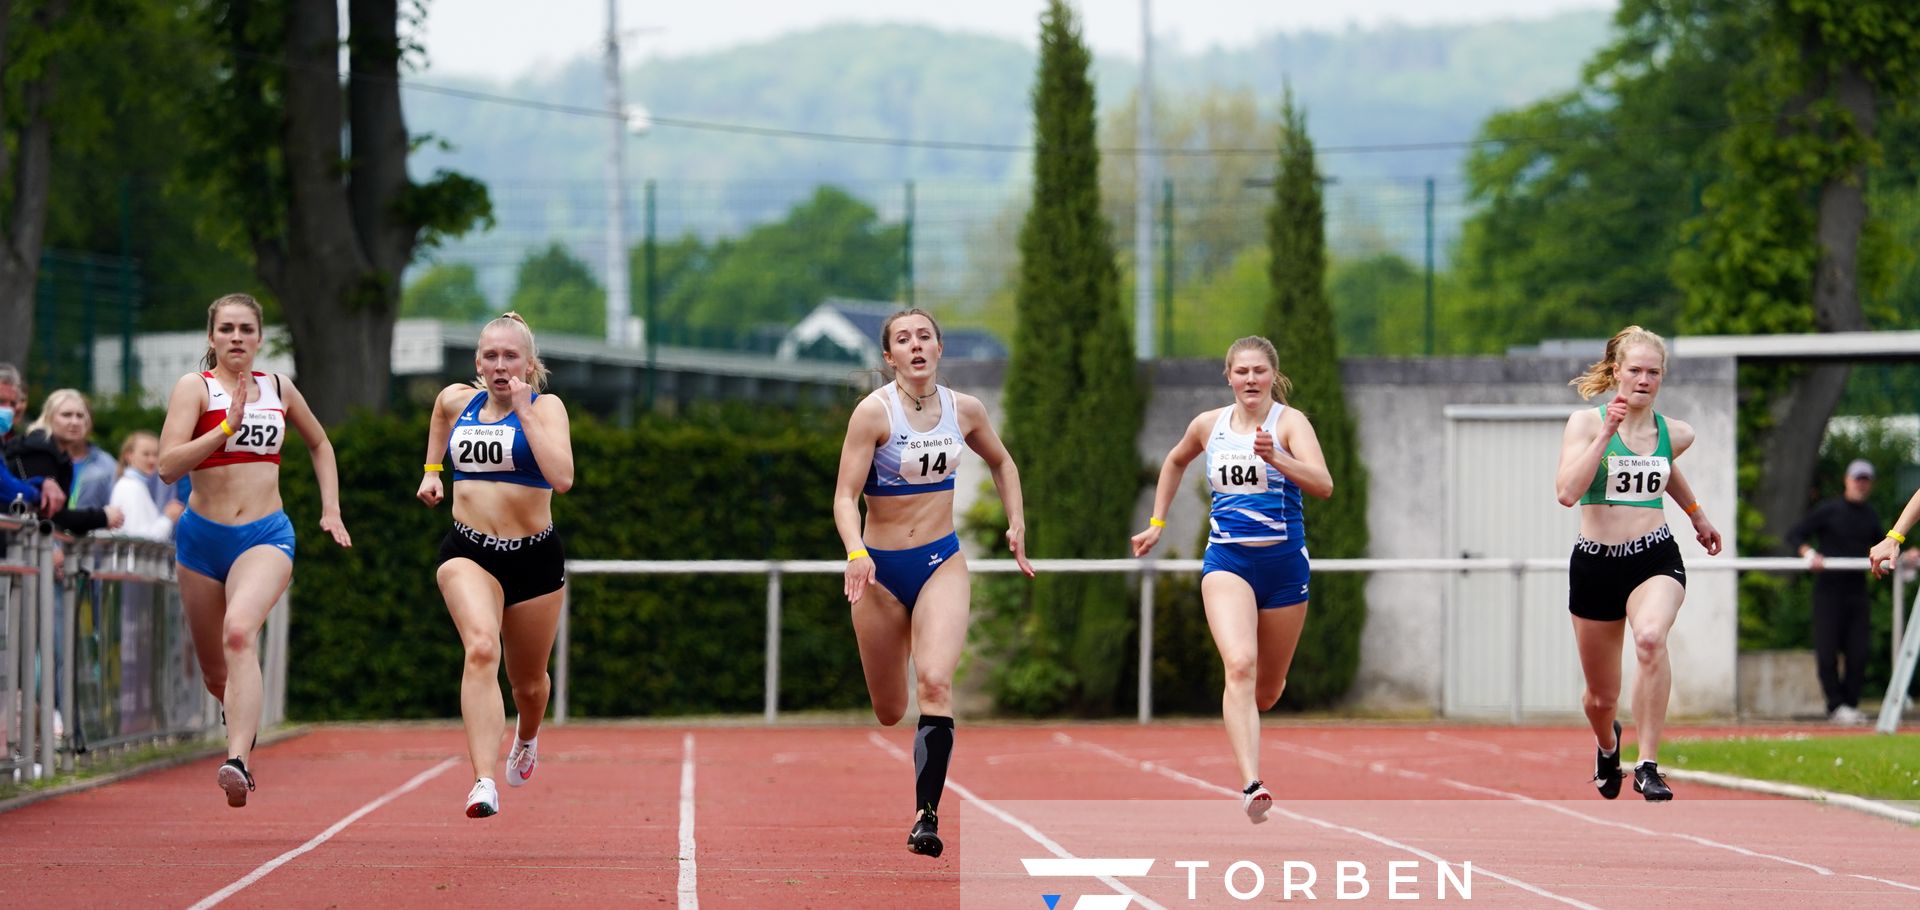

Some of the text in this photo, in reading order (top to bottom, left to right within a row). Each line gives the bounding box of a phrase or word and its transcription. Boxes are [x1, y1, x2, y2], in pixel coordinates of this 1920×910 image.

[235, 423, 278, 447] 252
[462, 428, 504, 437] SC Melle 03
[910, 440, 921, 449] SC
[923, 439, 943, 448] Melle
[944, 437, 953, 446] 03
[458, 439, 503, 465] 200
[918, 451, 947, 477] 14
[1618, 459, 1661, 468] SC Melle 03
[1218, 464, 1259, 486] 184
[1615, 471, 1662, 494] 316
[482, 534, 523, 552] PRO
[1575, 524, 1671, 558] PRO NIKE PRO
